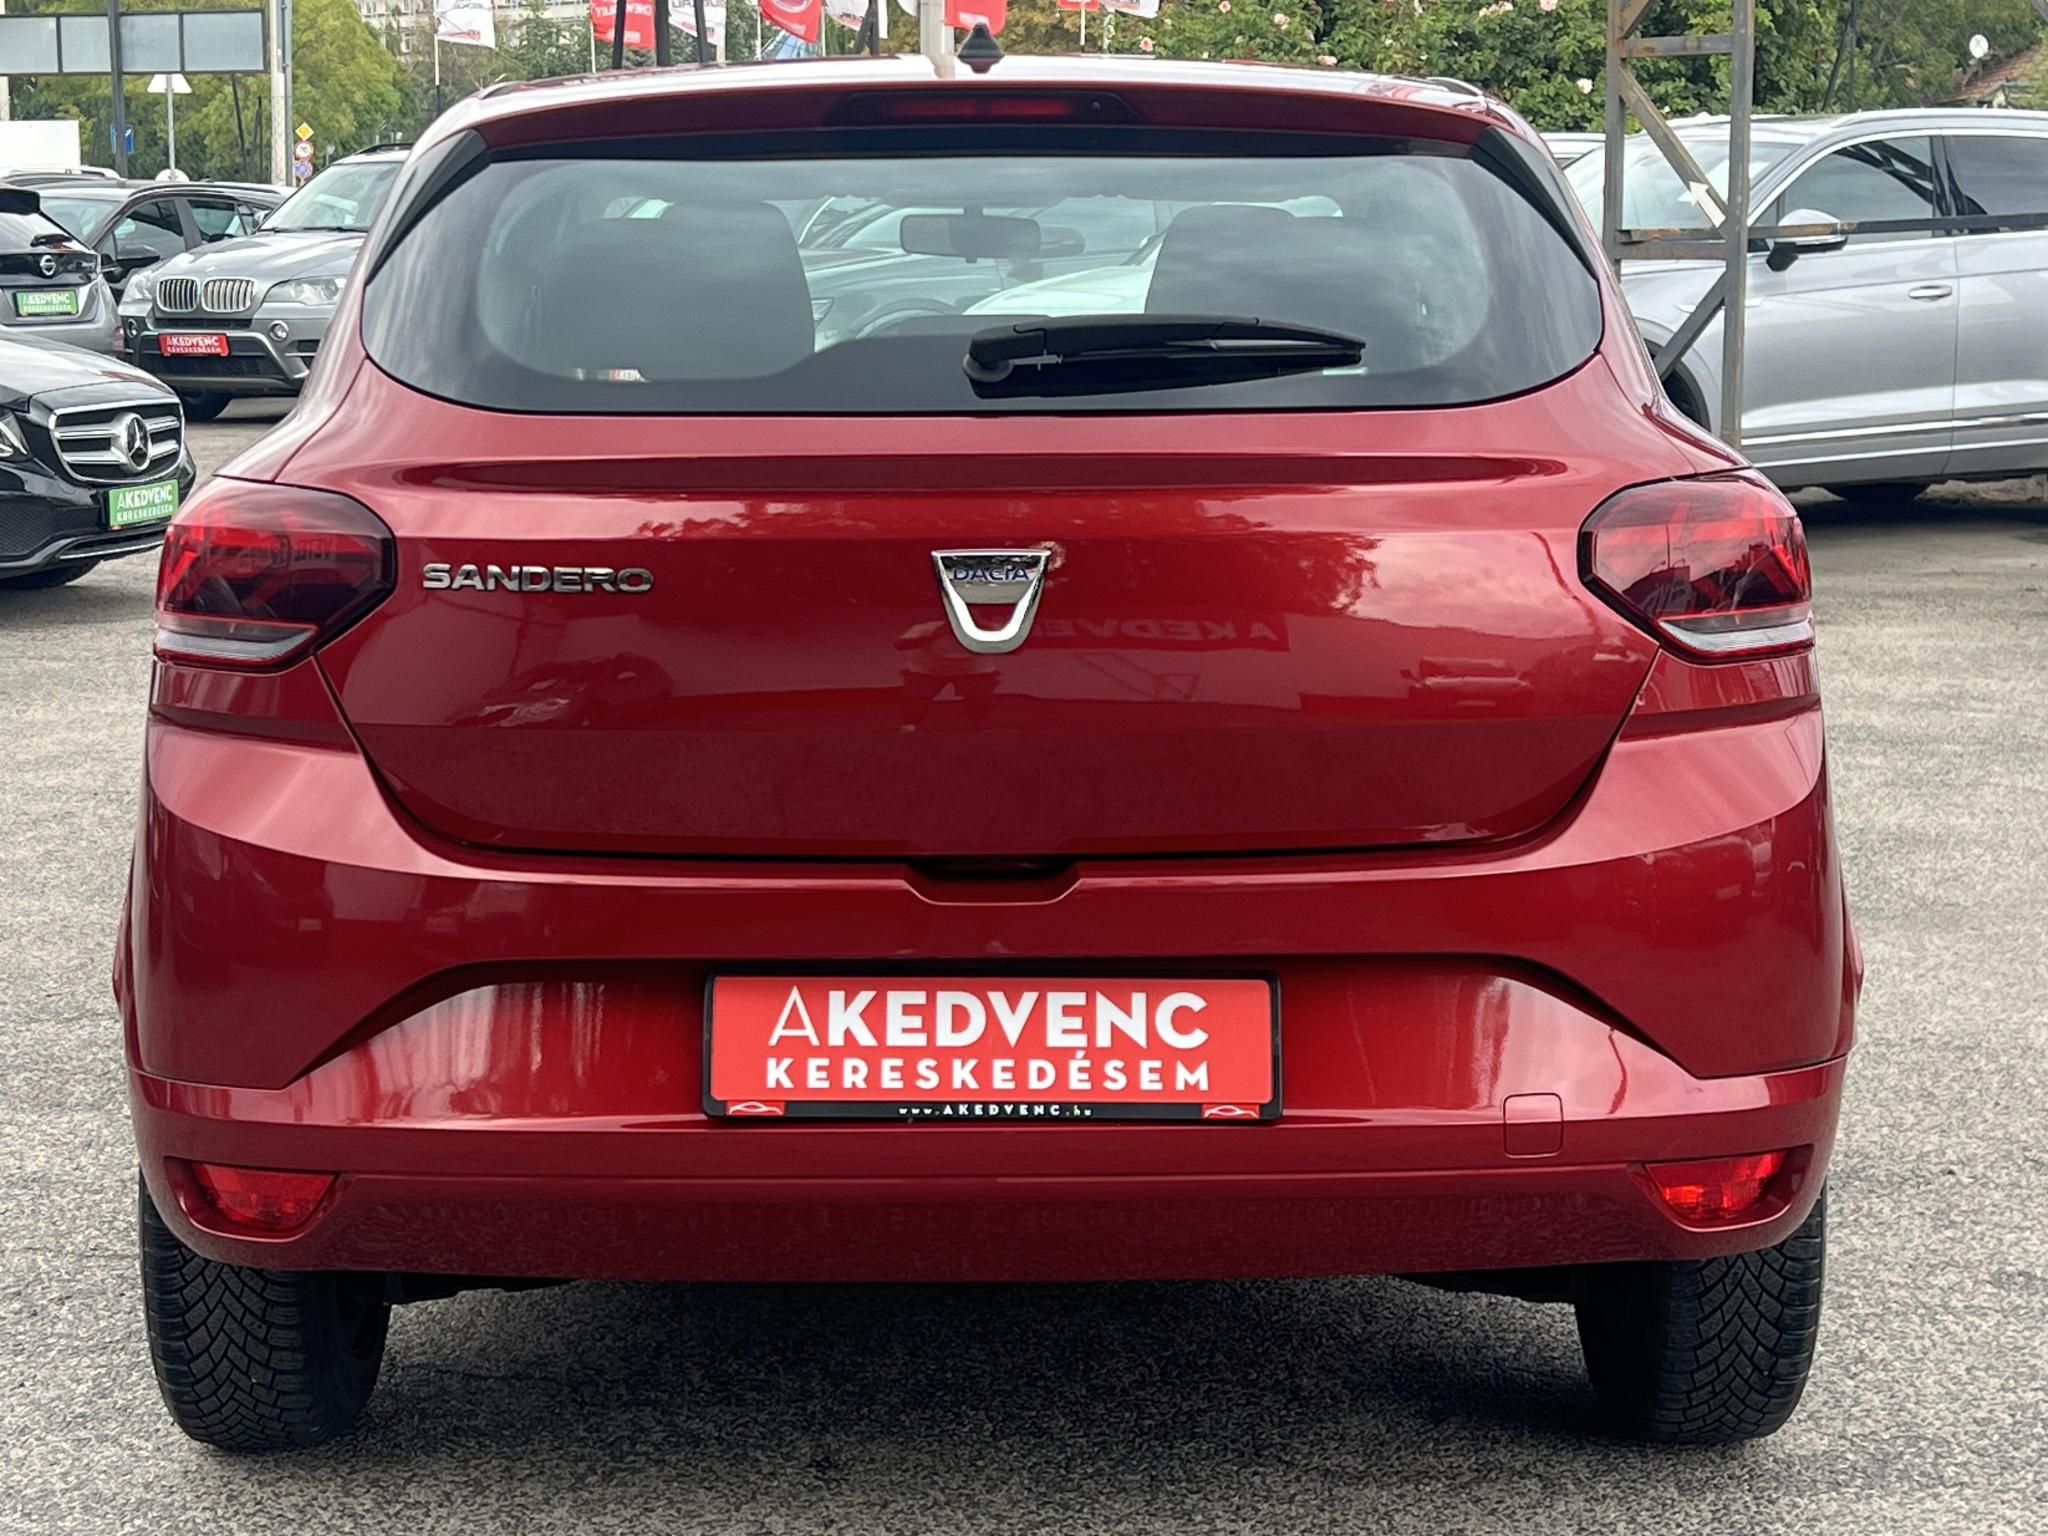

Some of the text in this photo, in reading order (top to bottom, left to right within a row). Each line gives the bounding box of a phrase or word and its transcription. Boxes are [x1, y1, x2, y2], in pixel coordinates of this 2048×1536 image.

[166, 335, 220, 346] AKEDVENC
[116, 484, 174, 510] AKEDVENC
[423, 563, 654, 592] SANDERO
[953, 566, 1029, 581] DACIA
[768, 985, 1209, 1049] AKEDVENC
[766, 1051, 1209, 1091] KERESKEDÉSEM
[899, 1104, 1091, 1116] www.AKEDVENC.hu
